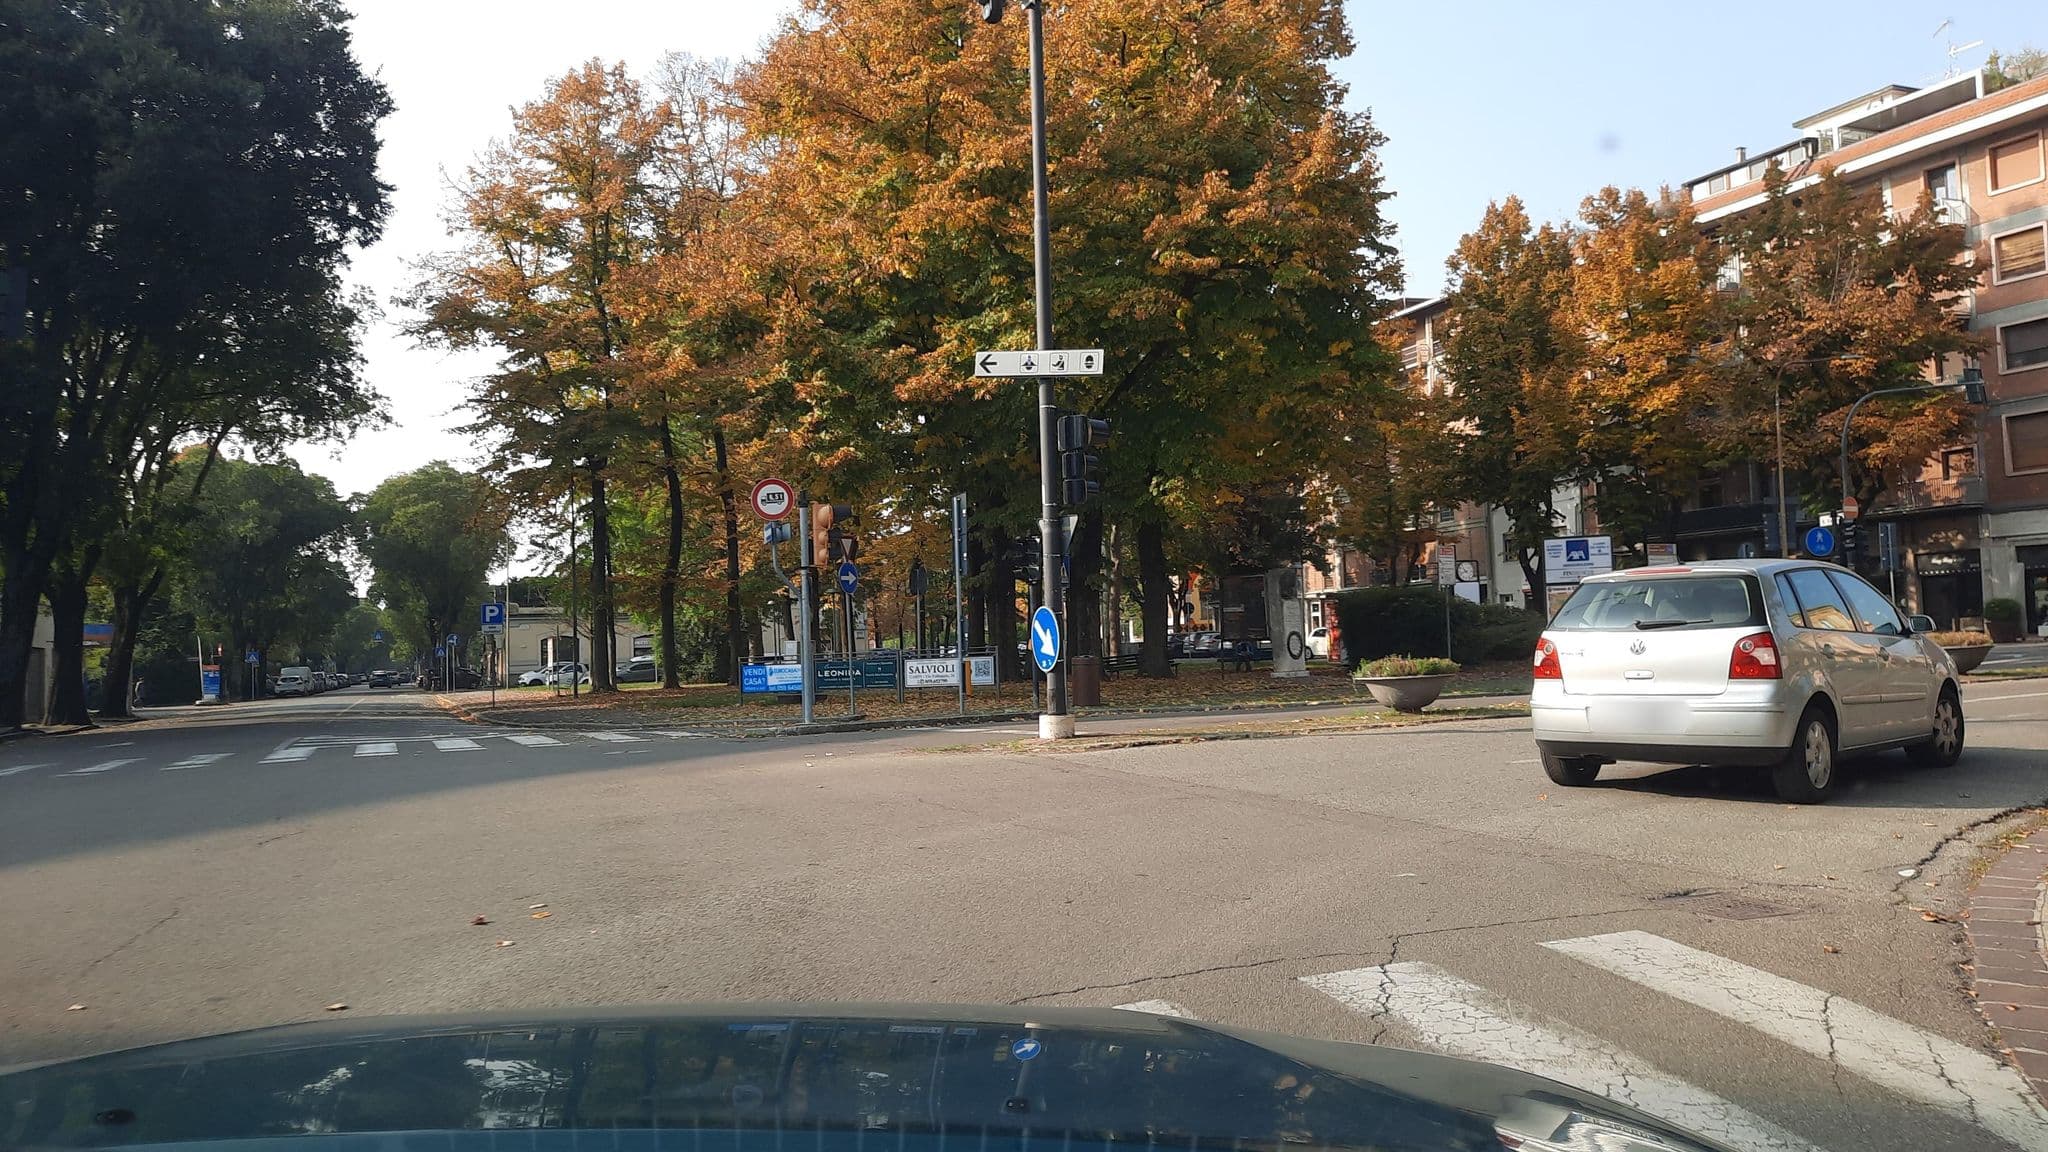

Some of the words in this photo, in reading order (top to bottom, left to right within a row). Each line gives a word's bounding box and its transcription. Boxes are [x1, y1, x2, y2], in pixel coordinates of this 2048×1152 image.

[485, 605, 499, 622] P
[744, 668, 766, 676] VENDI
[908, 664, 955, 674] SALVIOLI
